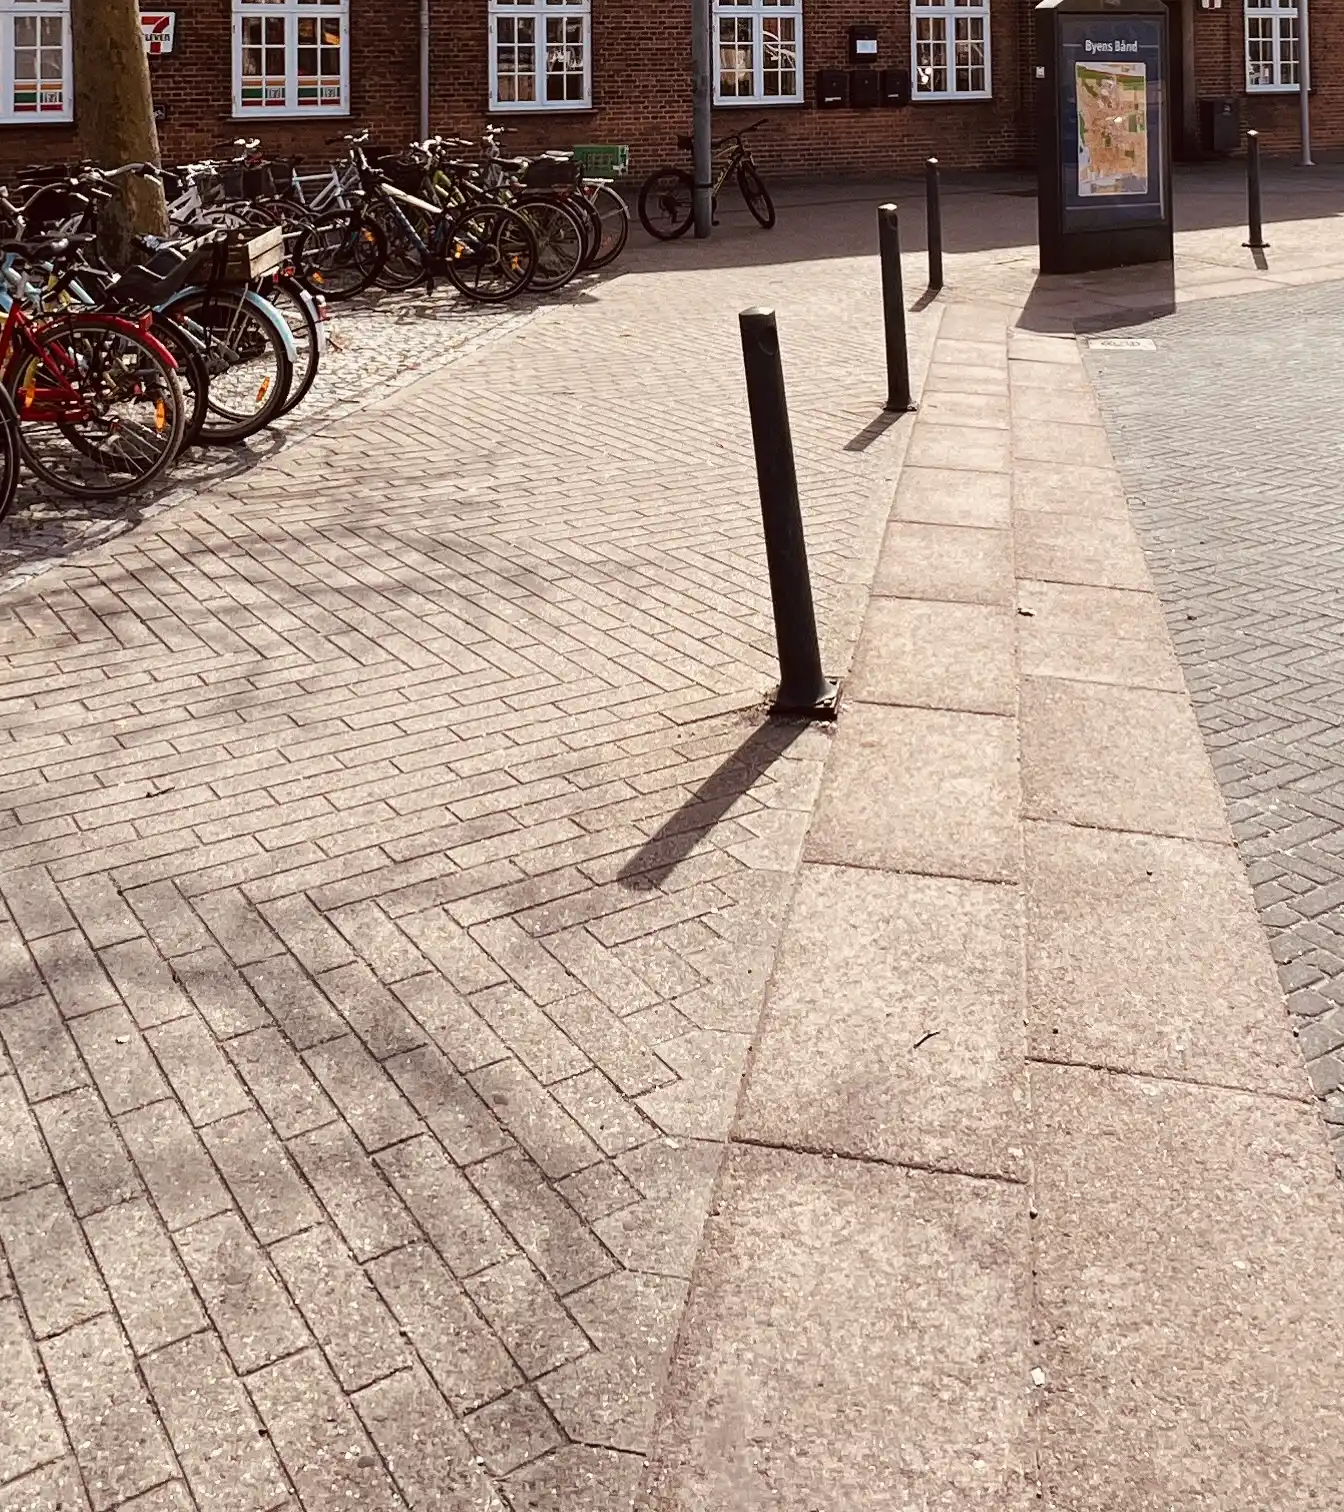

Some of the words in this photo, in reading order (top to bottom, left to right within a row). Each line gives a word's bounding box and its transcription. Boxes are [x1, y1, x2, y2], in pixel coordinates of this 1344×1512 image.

[141, 16, 170, 54] 7
[1085, 39, 1113, 54] Byens
[1114, 39, 1138, 53] Bånd
